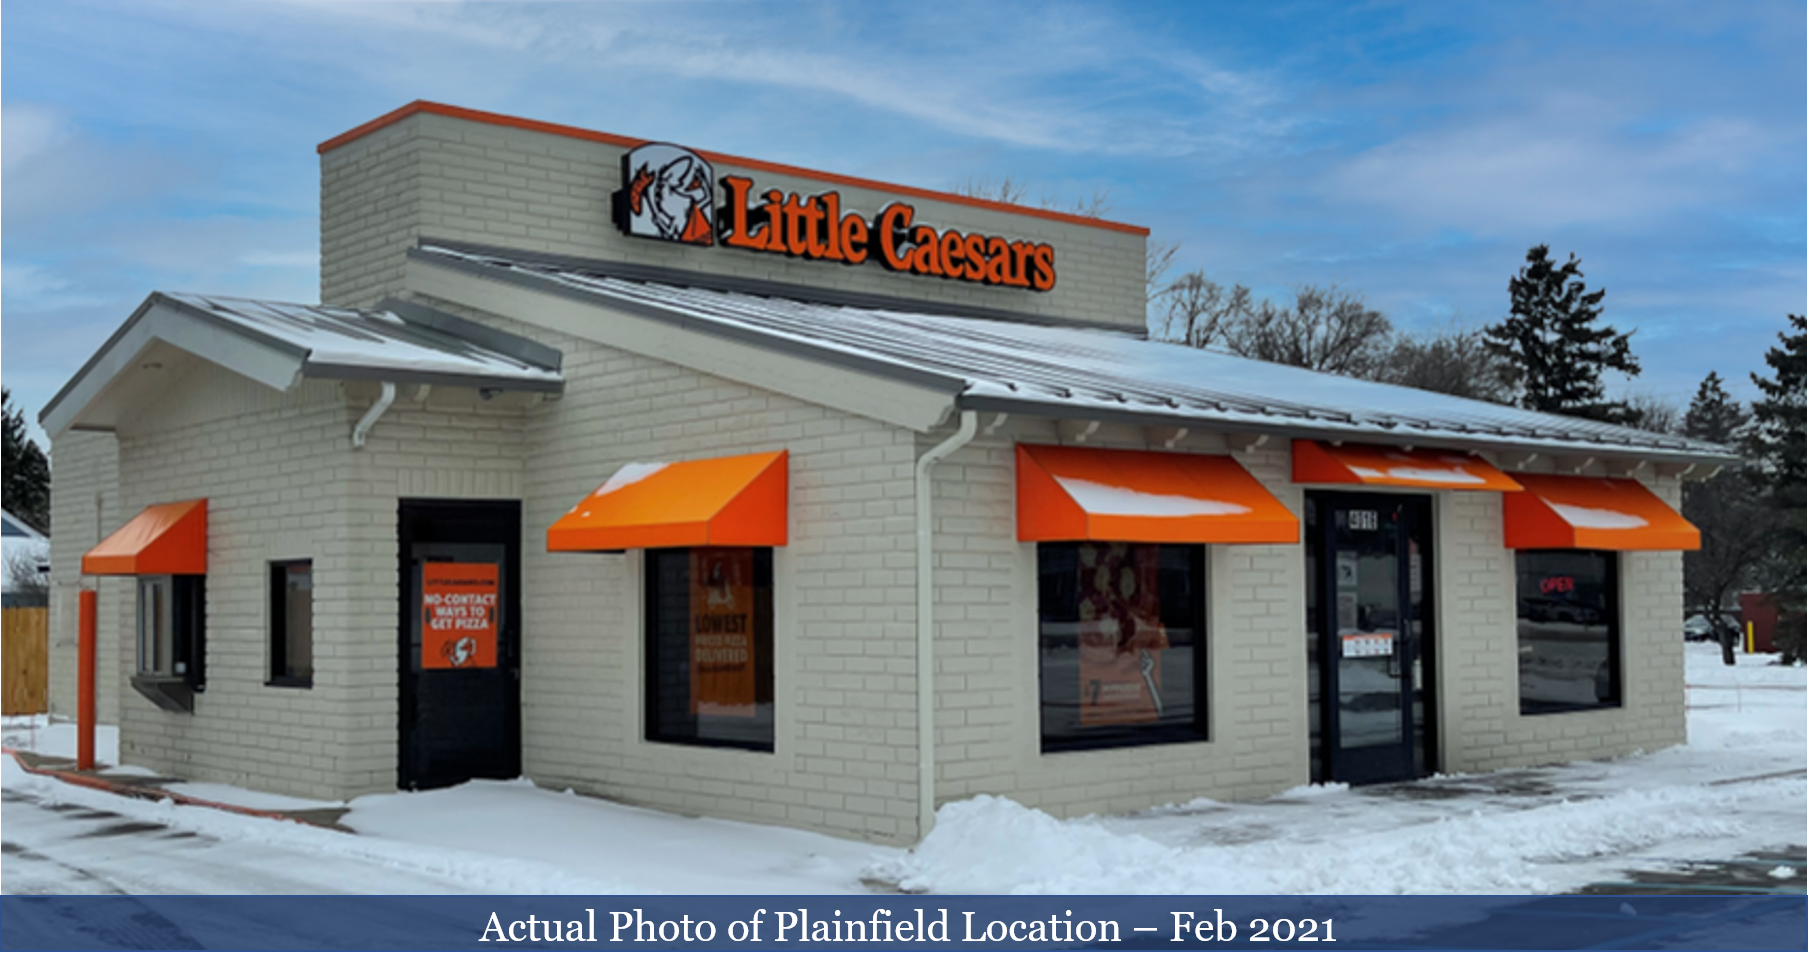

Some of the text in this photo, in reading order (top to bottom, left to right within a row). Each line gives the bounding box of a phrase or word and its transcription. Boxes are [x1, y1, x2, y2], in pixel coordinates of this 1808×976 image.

[728, 177, 1055, 291] Little Caesars
[1540, 576, 1574, 594] OPEN
[424, 593, 496, 605] NO-CONTACT
[435, 606, 486, 617] WAYS TO
[430, 618, 490, 630] GET PIZZA
[695, 613, 747, 633] LOWEST
[695, 648, 748, 662] DELIVERED
